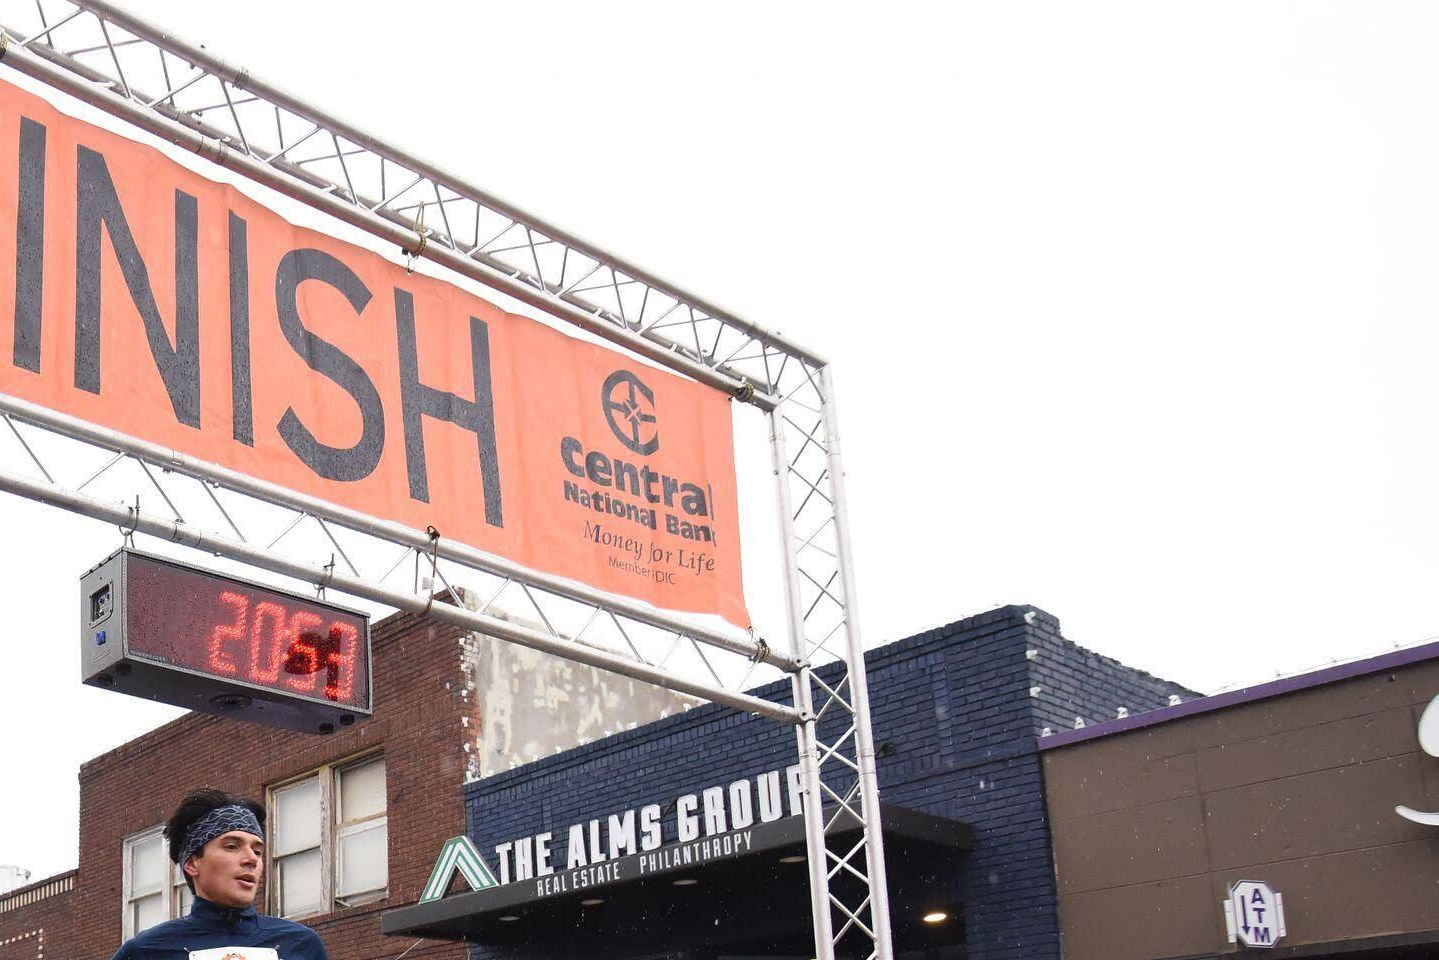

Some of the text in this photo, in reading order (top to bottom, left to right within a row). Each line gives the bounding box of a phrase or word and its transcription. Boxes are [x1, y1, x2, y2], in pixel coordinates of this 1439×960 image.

[564, 480, 656, 530] National
[584, 520, 715, 576] Money for Life
[496, 832, 554, 885] THE
[567, 804, 663, 869] ALMS
[537, 831, 752, 897] REAL ESTATE PHILANTHROPY
